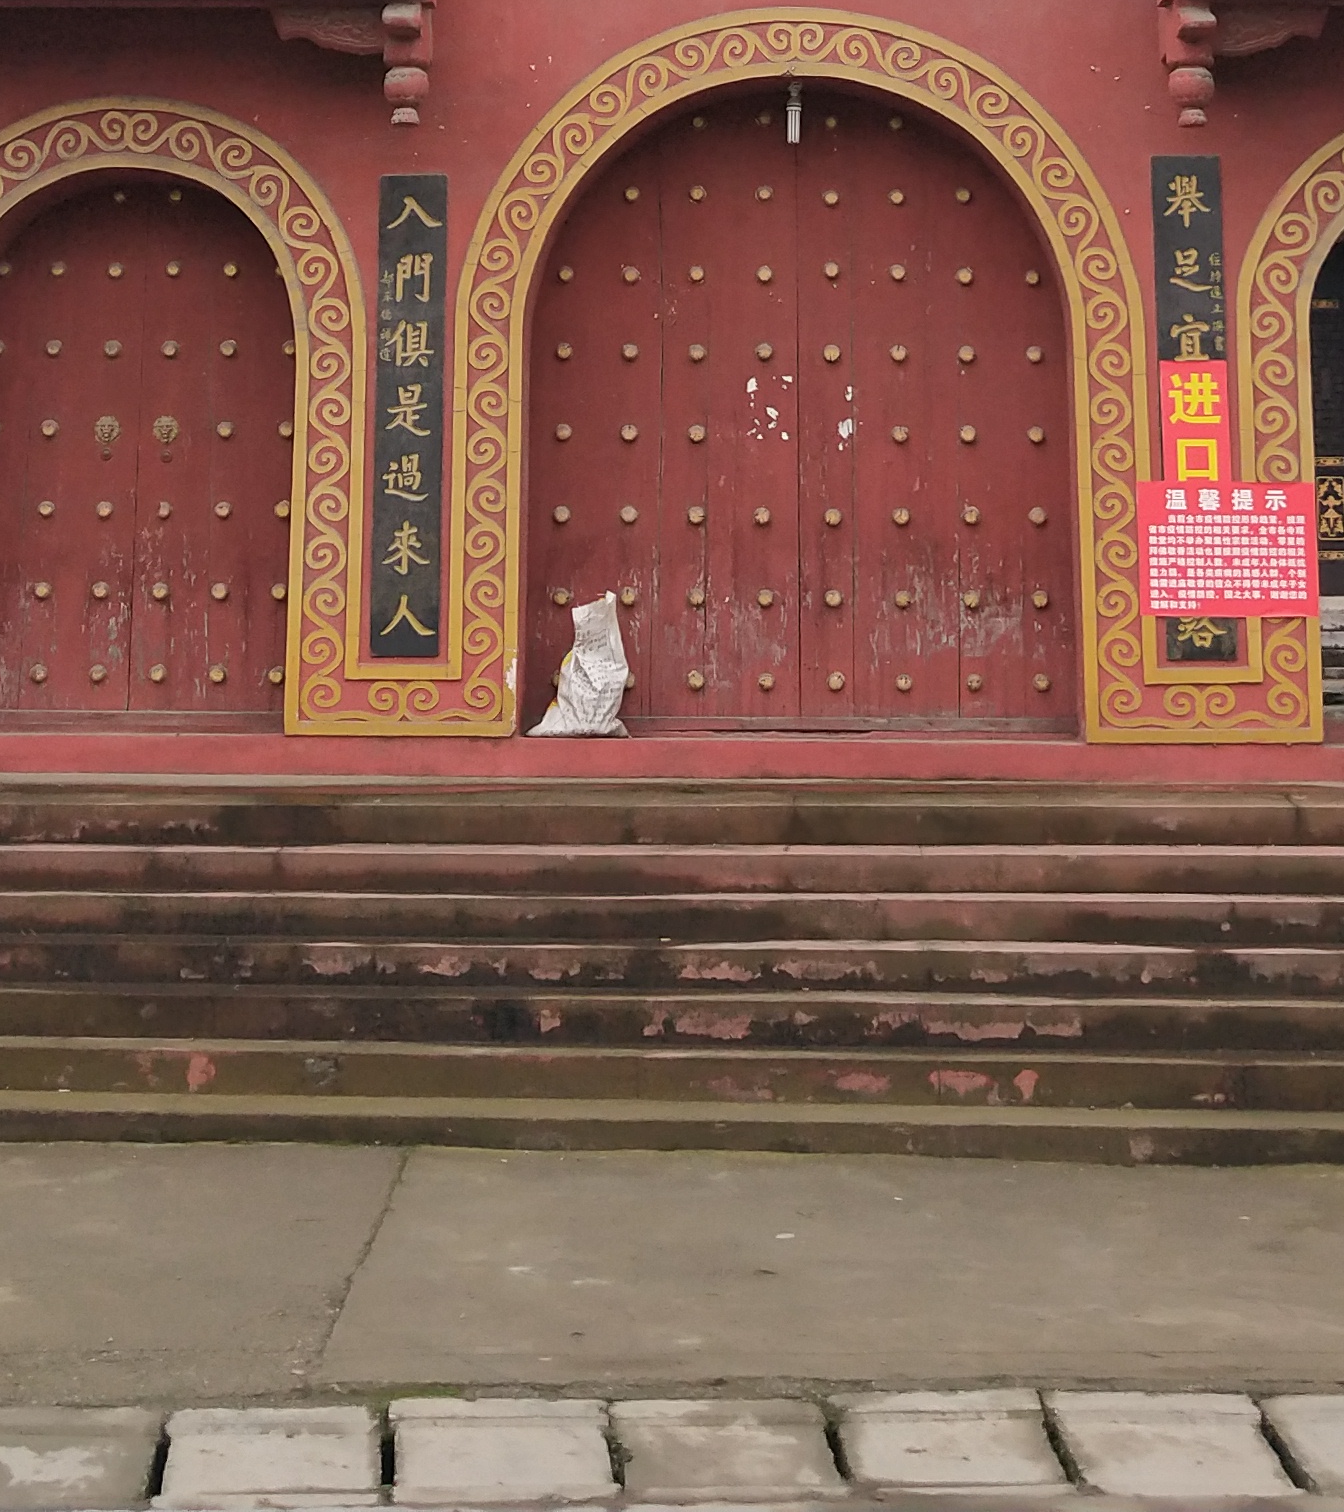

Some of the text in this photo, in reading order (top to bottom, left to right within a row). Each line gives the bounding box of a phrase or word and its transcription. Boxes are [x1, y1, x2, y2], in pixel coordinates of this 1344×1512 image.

[1168, 373, 1222, 482] 进口
[1165, 489, 1287, 511] 温馨提示
